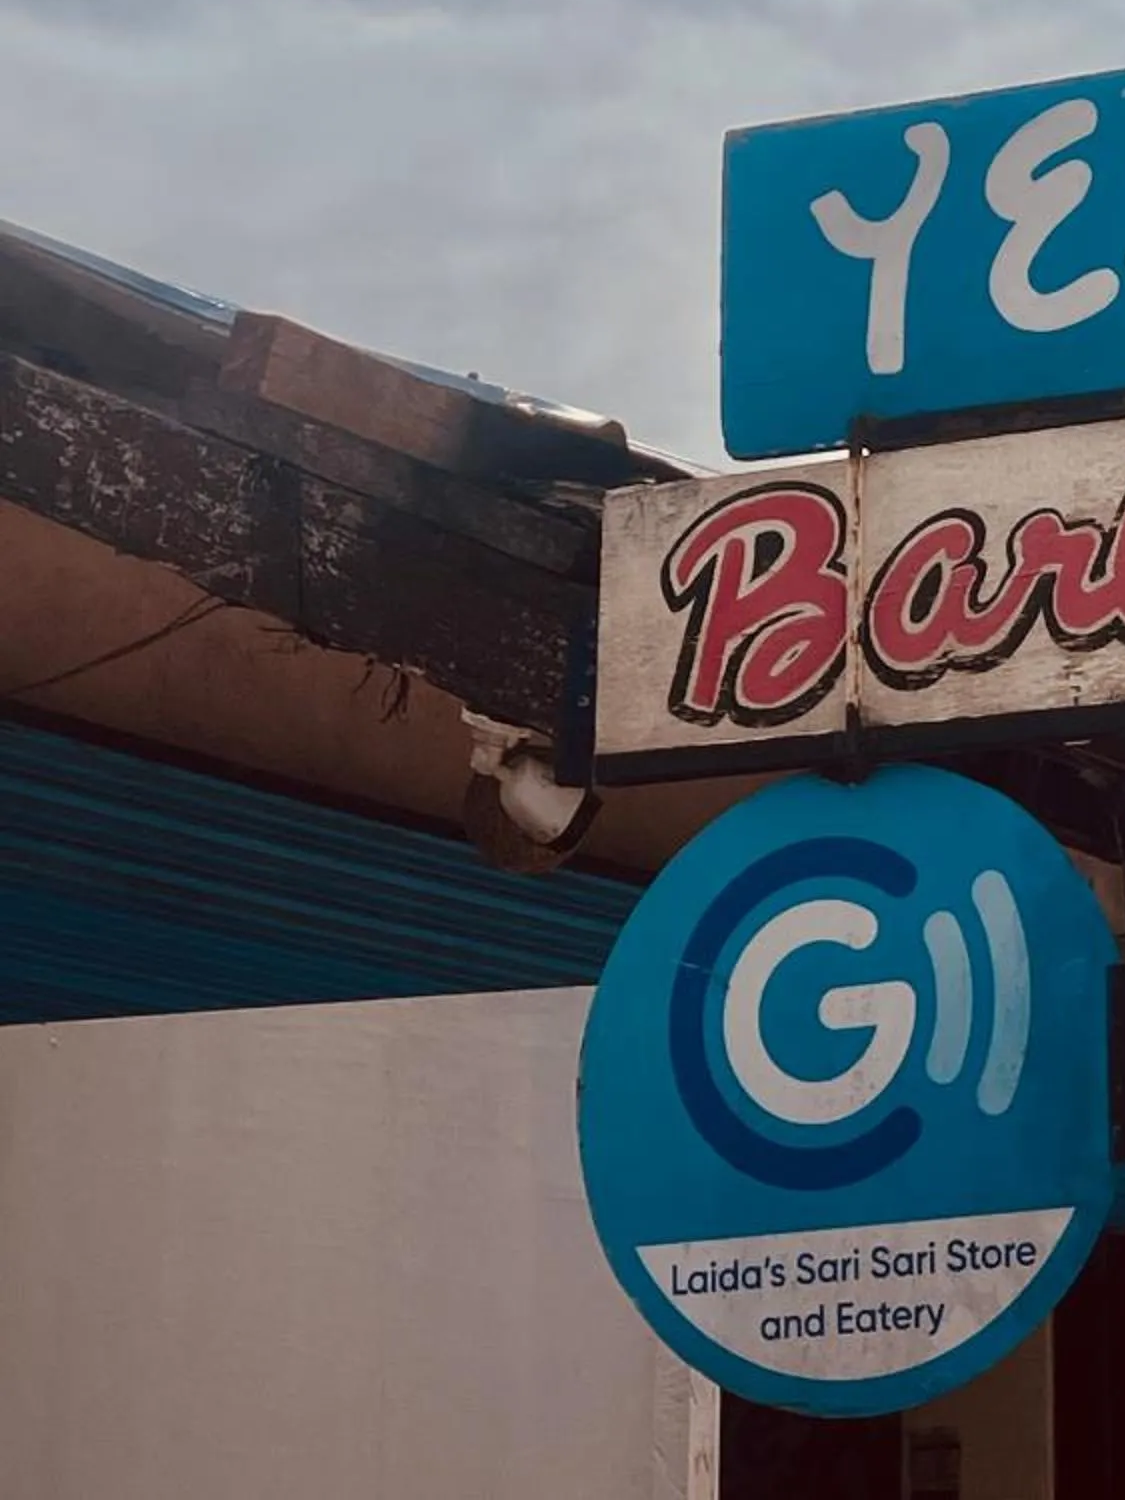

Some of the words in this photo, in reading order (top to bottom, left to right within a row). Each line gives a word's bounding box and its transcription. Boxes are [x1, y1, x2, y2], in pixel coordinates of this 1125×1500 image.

[670, 1256, 786, 1297] Laida's
[795, 1247, 860, 1286] Sari
[870, 1241, 936, 1279] Sari
[945, 1238, 1038, 1274] Store
[760, 1304, 826, 1342] and
[836, 1302, 946, 1336] Eatery
